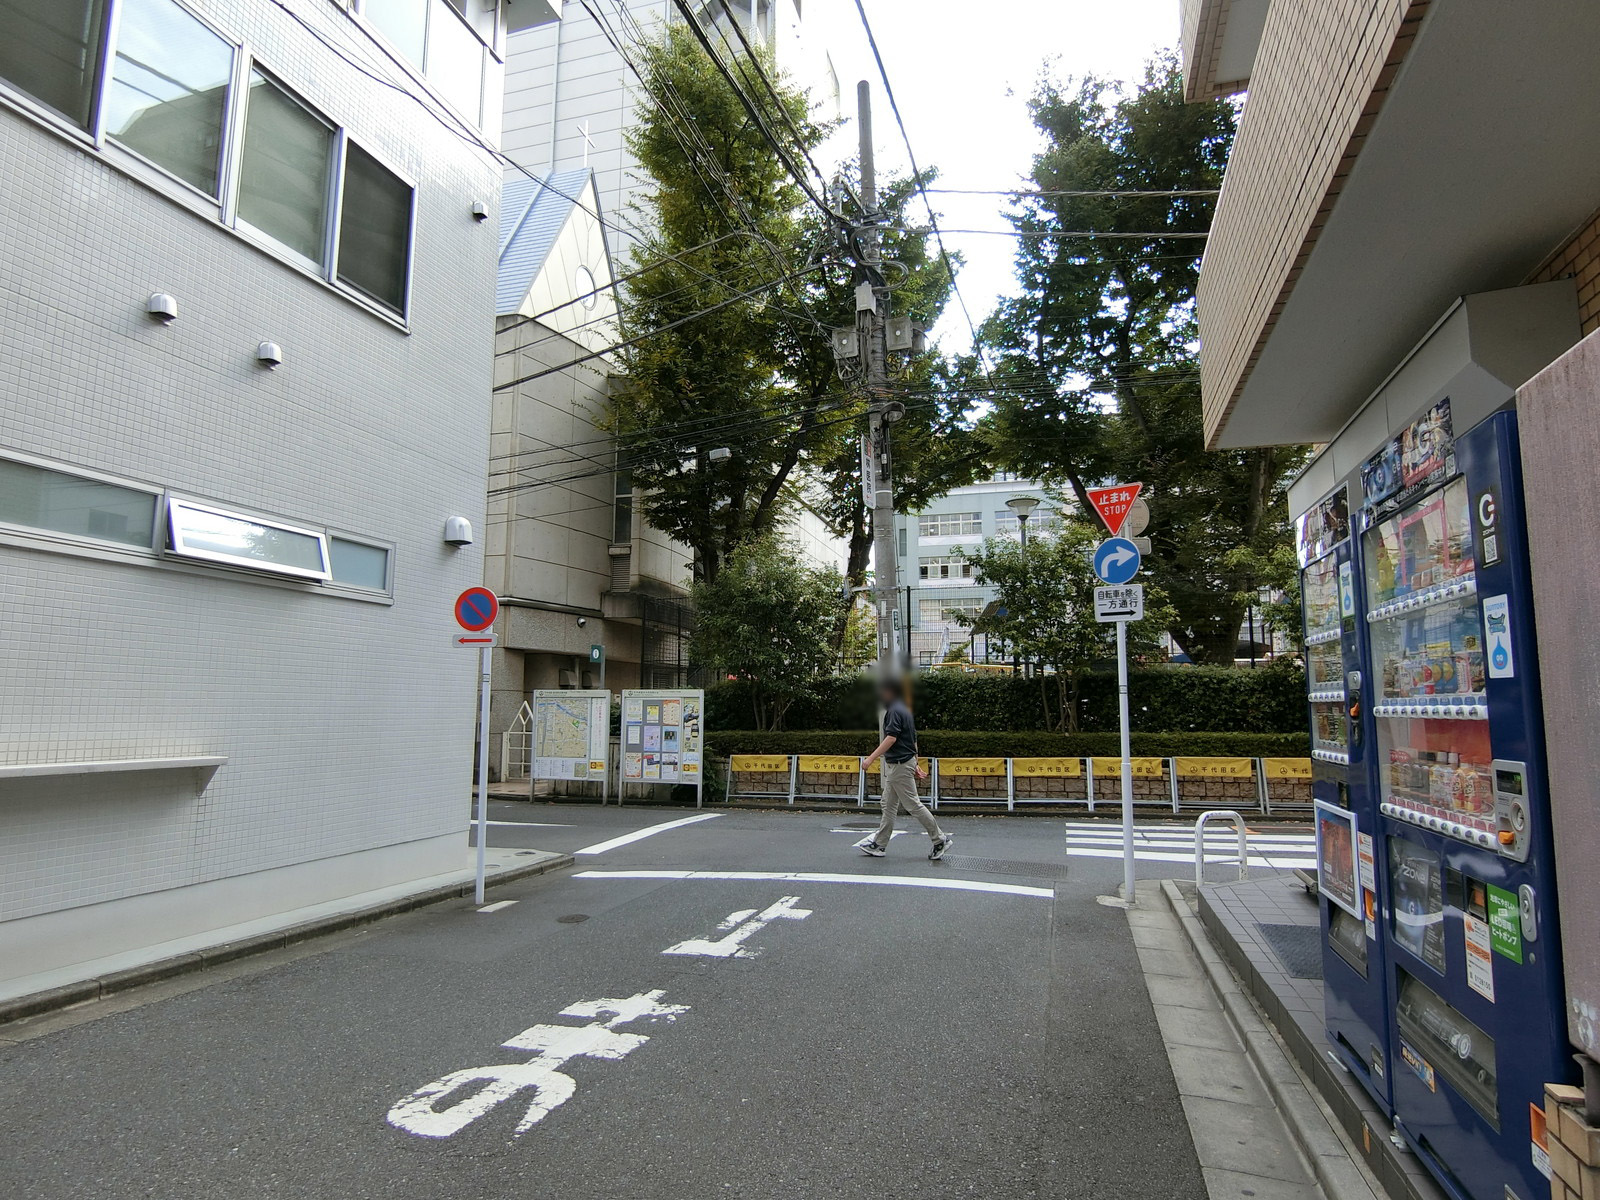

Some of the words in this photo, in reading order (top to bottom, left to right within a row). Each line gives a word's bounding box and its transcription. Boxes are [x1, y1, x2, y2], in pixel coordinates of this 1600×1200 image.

[1098, 491, 1130, 505] 止まれ
[1104, 504, 1127, 516] STOP
[1097, 588, 1138, 600] 自転車を除く
[1097, 600, 1138, 610] 一方通行
[1201, 766, 1238, 774] 千代田区
[1291, 767, 1309, 775] 千代
